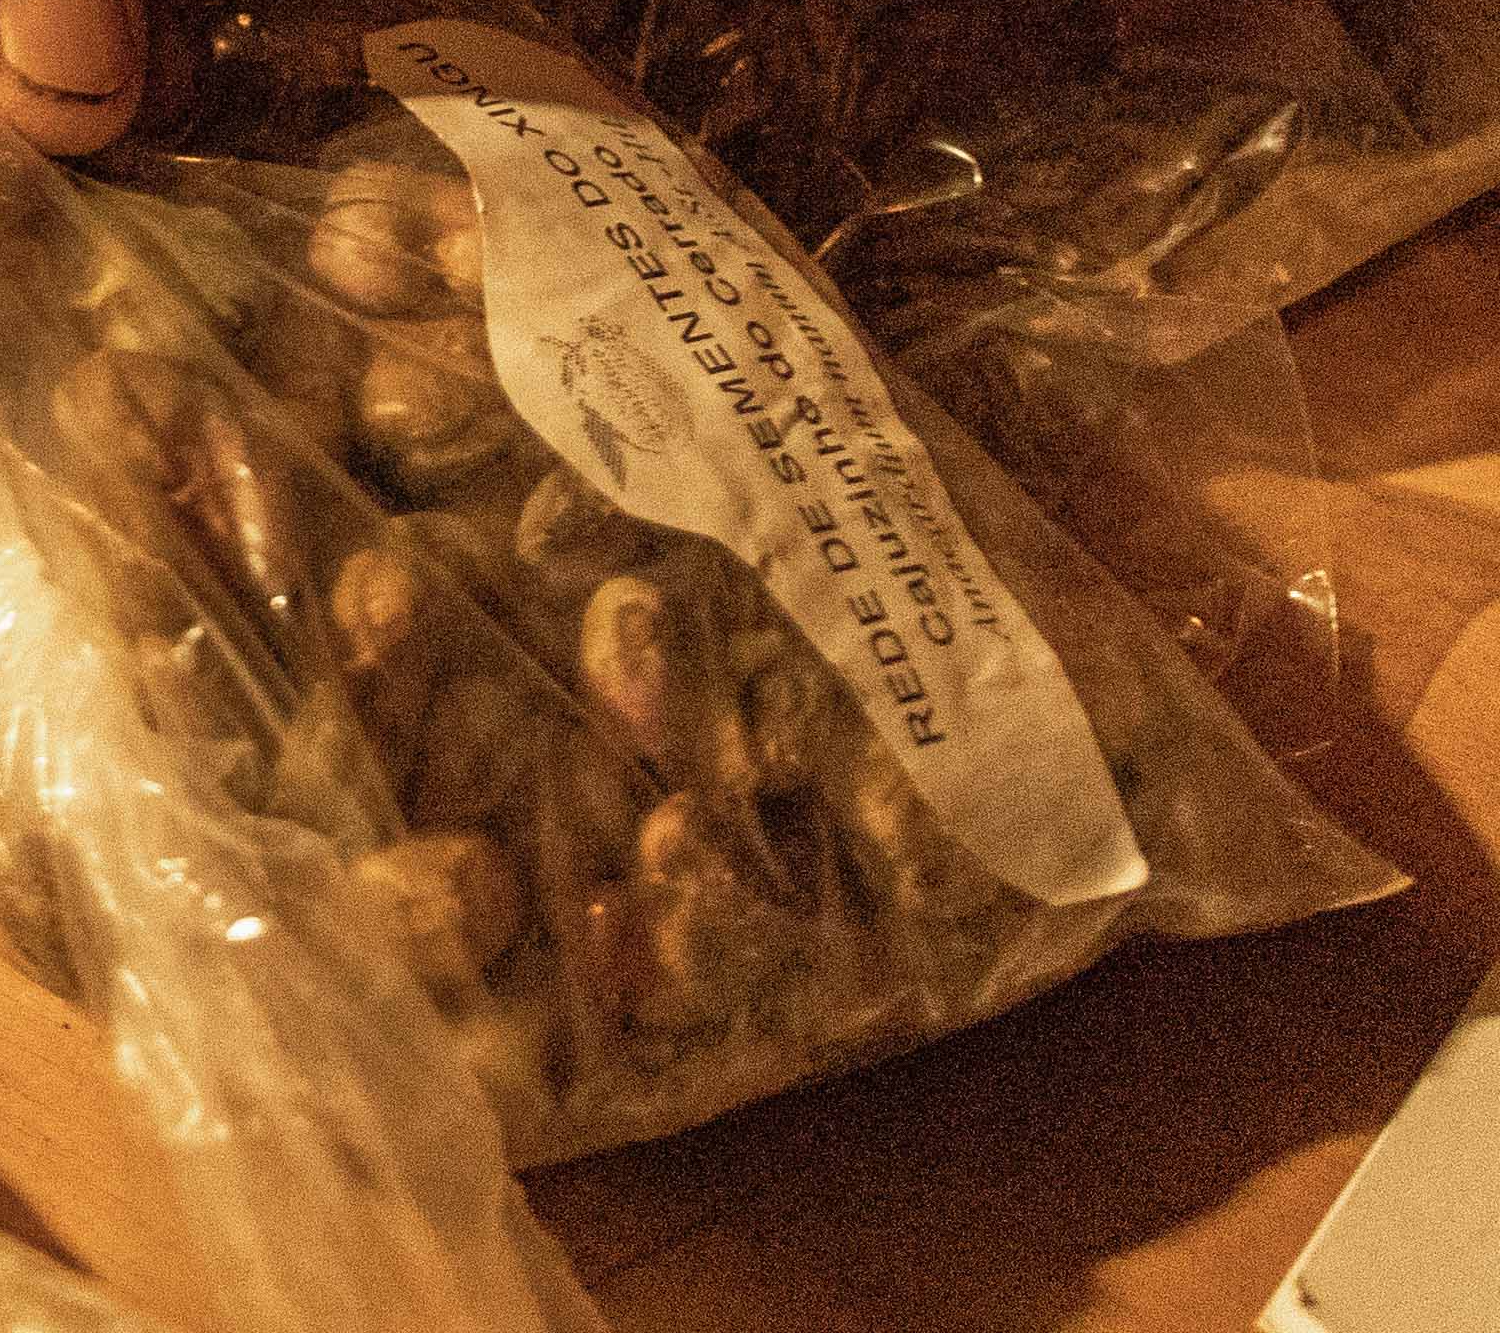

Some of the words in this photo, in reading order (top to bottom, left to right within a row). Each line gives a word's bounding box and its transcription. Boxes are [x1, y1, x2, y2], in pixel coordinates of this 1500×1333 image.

[395, 33, 542, 135] XINGU
[543, 149, 611, 207] DO
[593, 145, 741, 306] Cerrado
[605, 222, 807, 484] SEMENTES
[745, 320, 793, 376] do
[788, 395, 955, 646] Cajuzinho
[798, 504, 859, 573] DE
[850, 599, 945, 746] REDE
